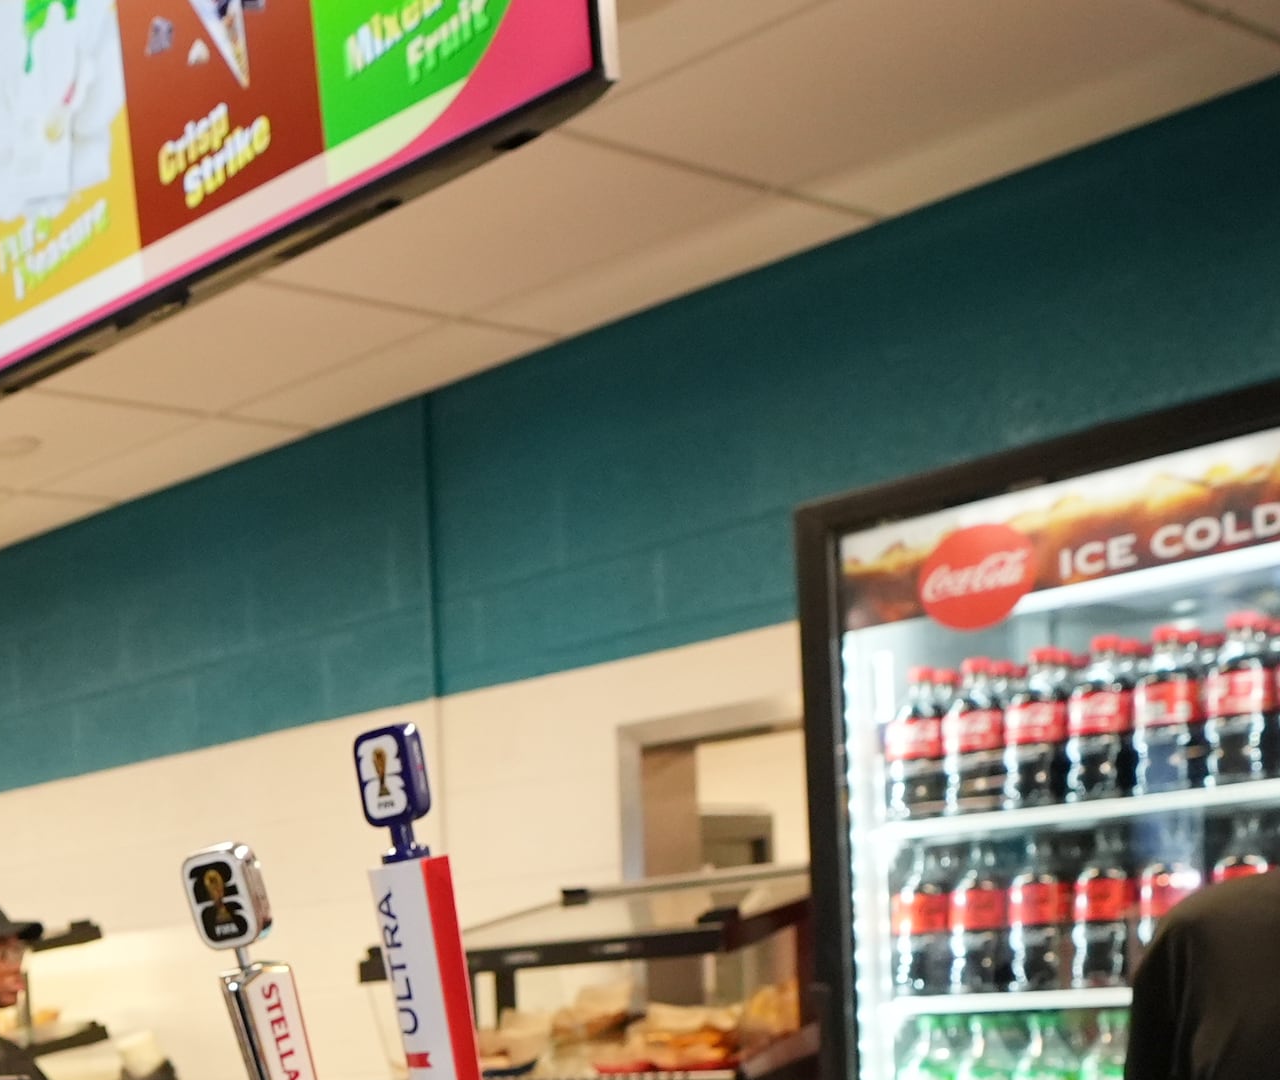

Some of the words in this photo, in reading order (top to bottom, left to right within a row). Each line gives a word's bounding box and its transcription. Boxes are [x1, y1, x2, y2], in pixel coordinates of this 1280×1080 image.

[405, 0, 491, 85] Fruit
[158, 102, 230, 186] Crisp
[183, 115, 271, 208] Strike
[1059, 533, 1139, 580] ICE
[378, 889, 421, 1036] ULTRA
